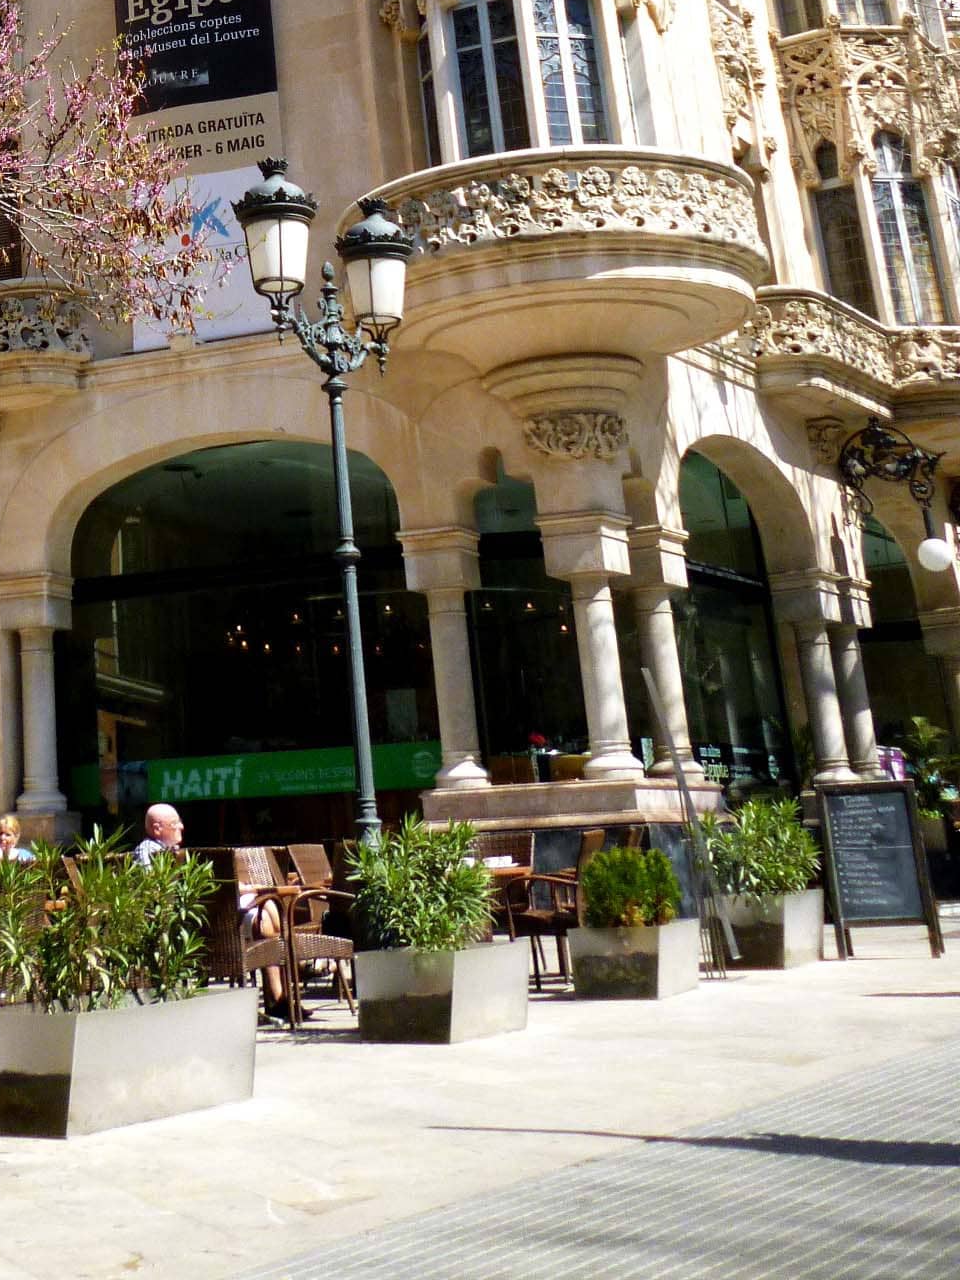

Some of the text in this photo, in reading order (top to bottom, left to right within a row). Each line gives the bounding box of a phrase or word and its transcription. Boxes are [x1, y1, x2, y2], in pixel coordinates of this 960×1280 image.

[200, 14, 242, 29] coptes
[145, 38, 187, 56] Museu
[190, 33, 210, 46] del
[215, 27, 260, 43] Louvre
[142, 112, 265, 144] NTRADA GRATUÏTA
[215, 142, 223, 155] 6
[227, 134, 265, 153] MAIG
